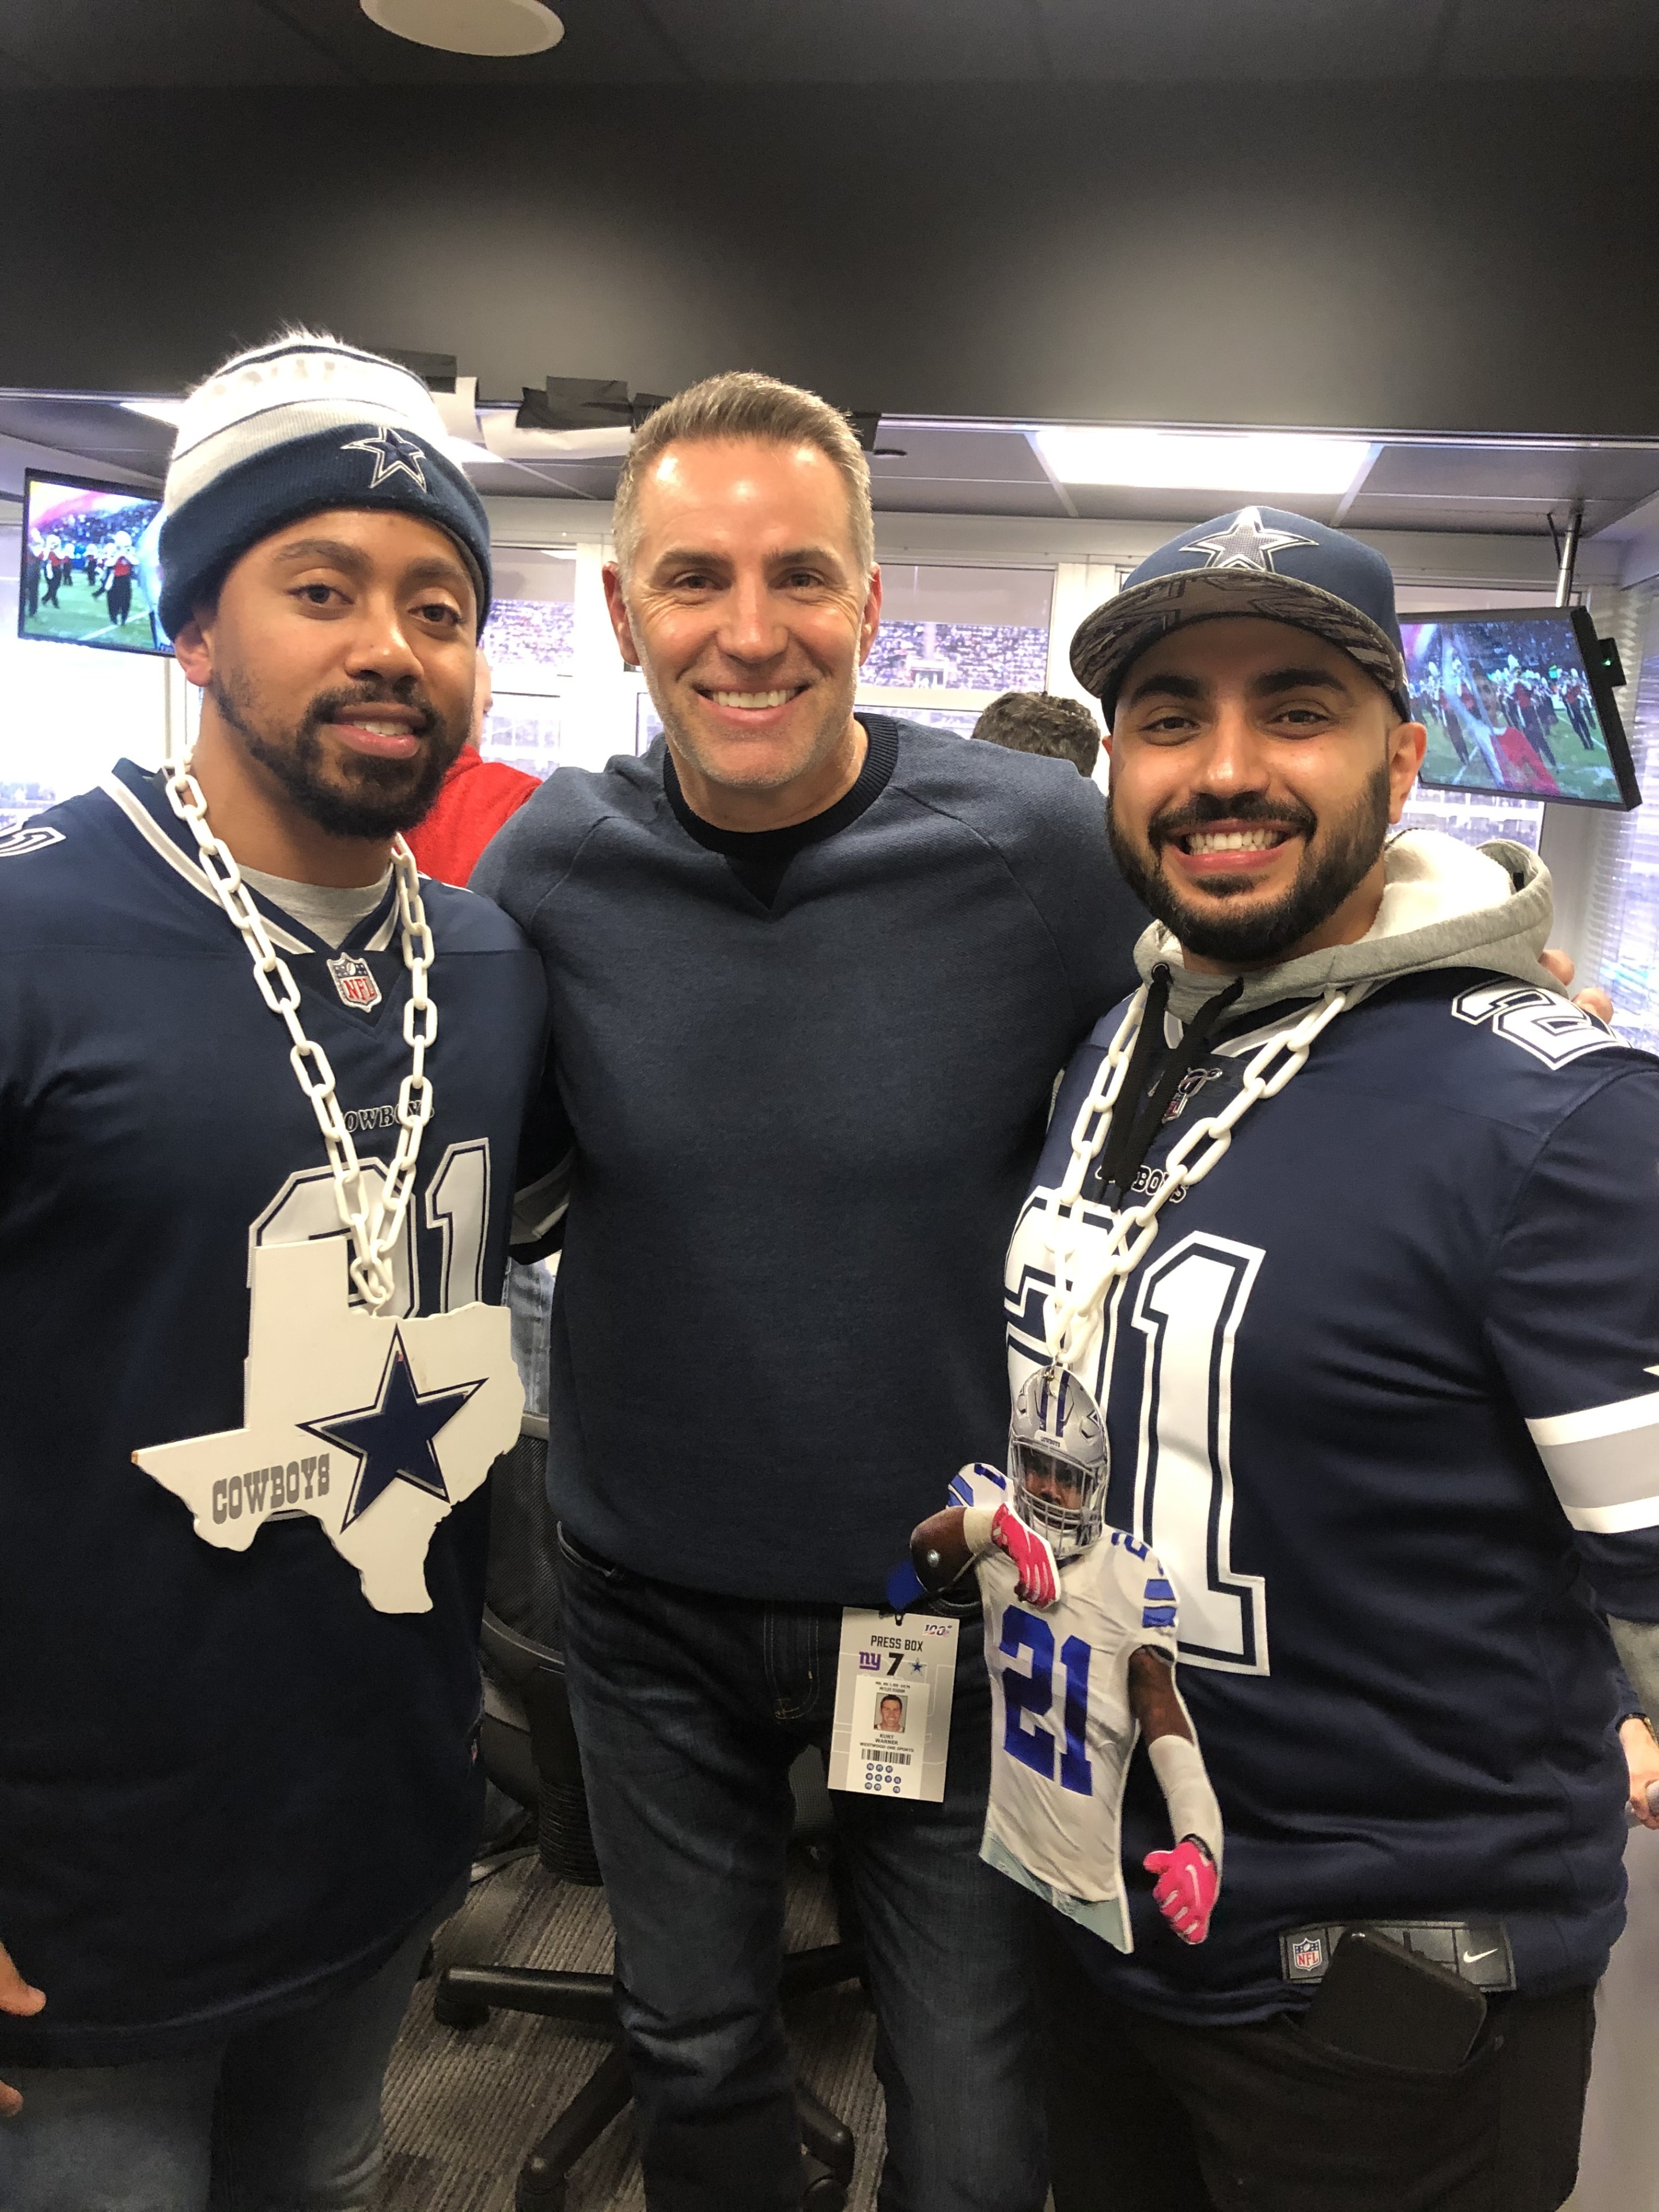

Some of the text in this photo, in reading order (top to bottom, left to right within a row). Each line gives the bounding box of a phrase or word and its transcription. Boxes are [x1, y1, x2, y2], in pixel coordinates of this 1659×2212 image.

[343, 978, 375, 1001] NFL
[213, 1453, 330, 1525] COWBOYS
[870, 1635, 923, 1652] PRESS BOX
[887, 1652, 904, 1676] 7
[999, 1604, 1093, 1797] 21
[1298, 1952, 1318, 1965] NFL
